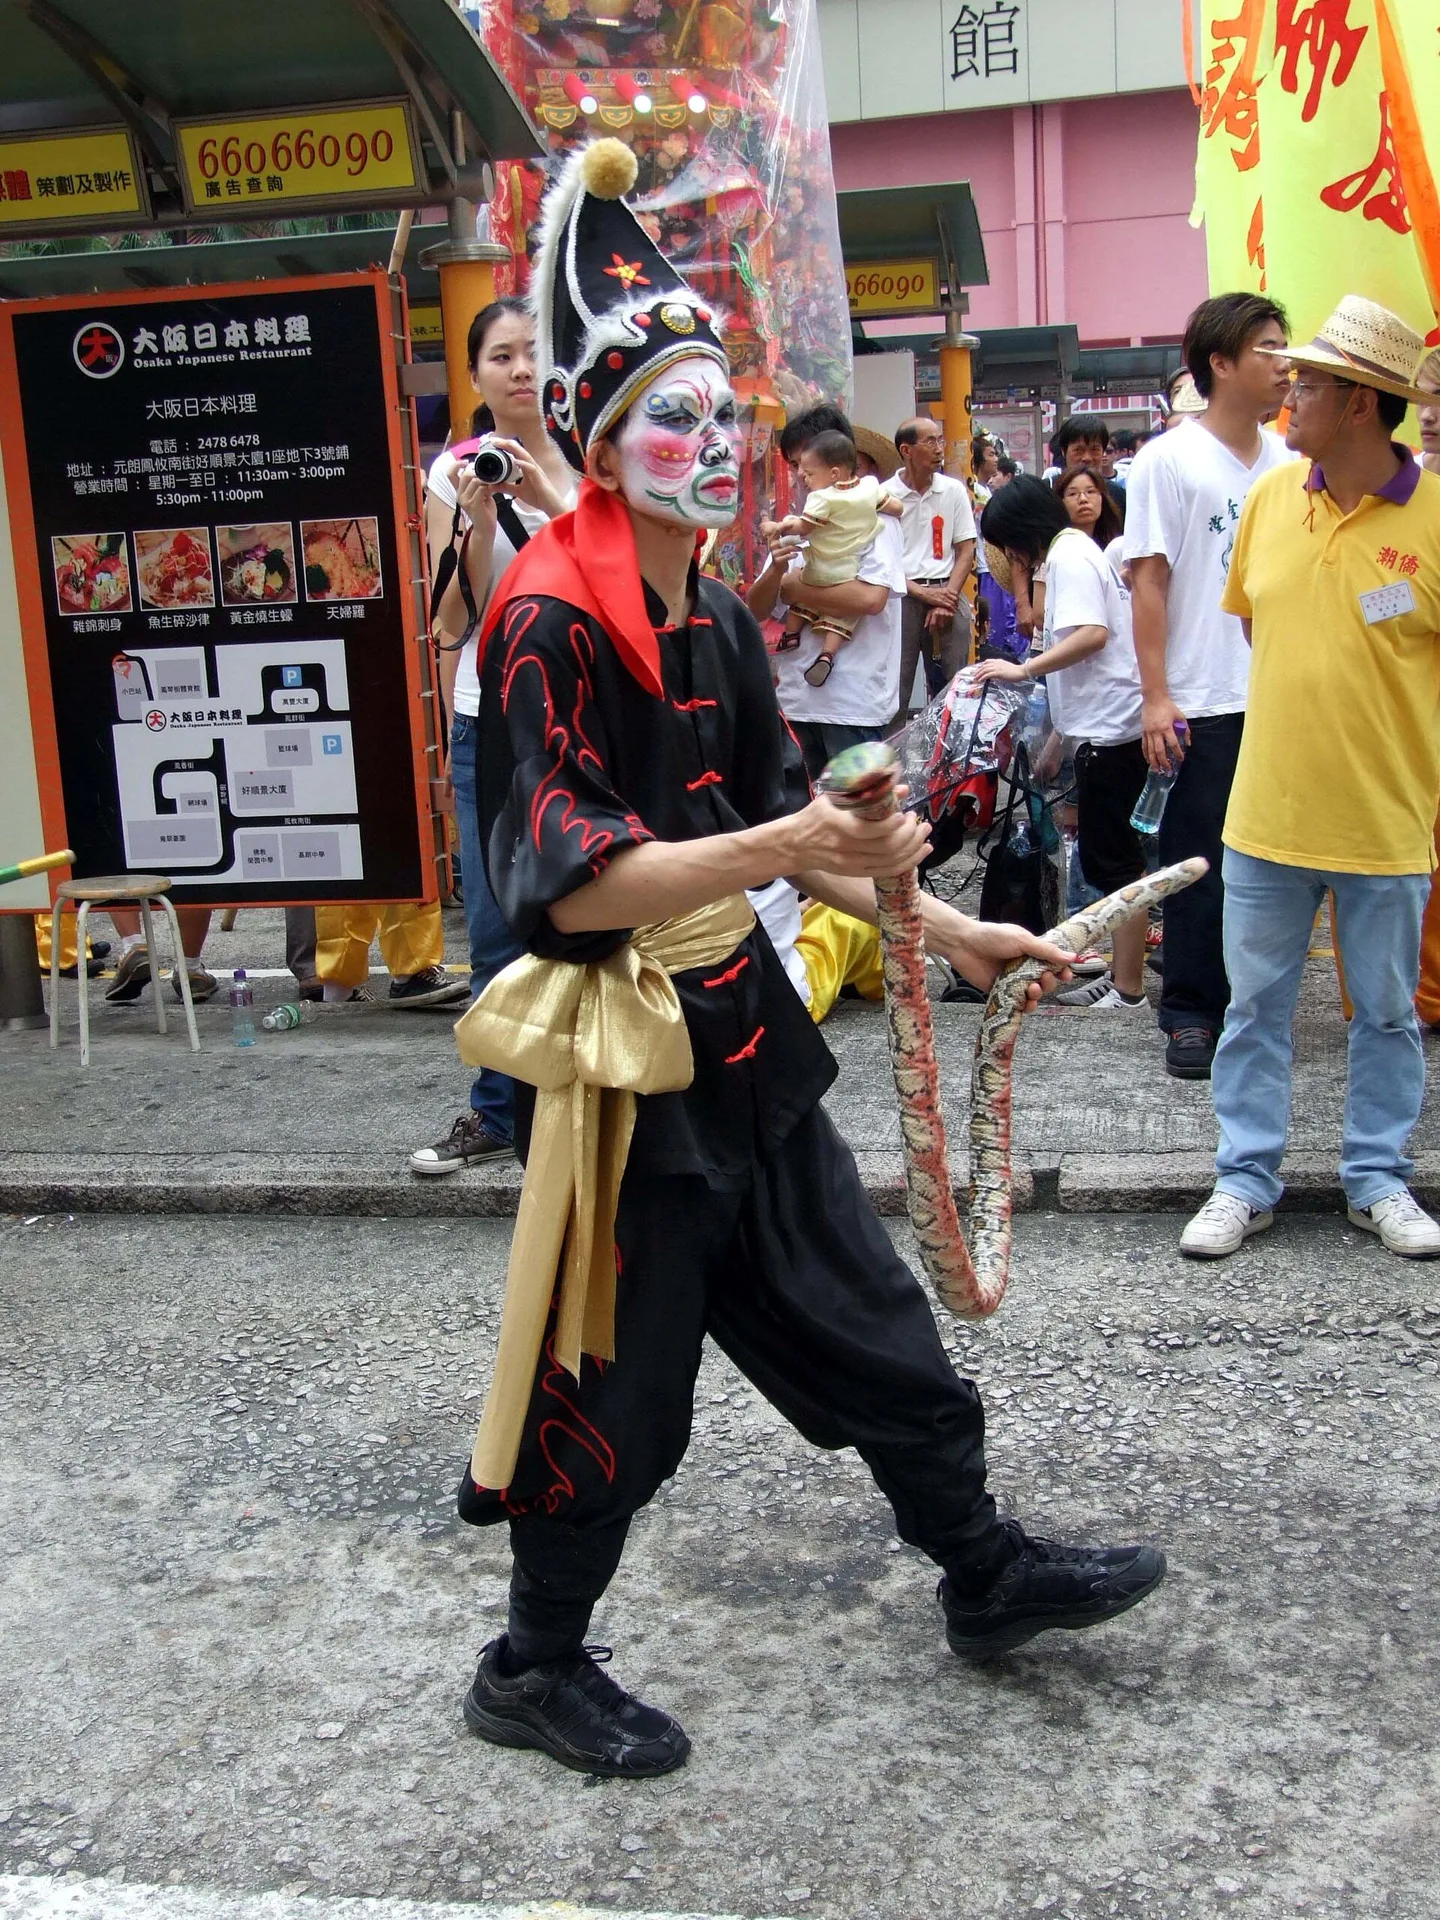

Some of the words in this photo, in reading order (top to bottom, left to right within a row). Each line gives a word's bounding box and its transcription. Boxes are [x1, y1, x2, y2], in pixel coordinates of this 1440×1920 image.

[949, 1, 1020, 81] 館
[198, 129, 394, 179] 66066090
[0, 169, 33, 201] 體
[36, 170, 132, 198] 策劃及製作
[205, 174, 284, 198] 廣告查詢
[132, 314, 312, 355] 大阪日本料理
[133, 357, 172, 369] Osaka
[176, 352, 235, 367] Japanese
[239, 346, 313, 360] Restaurant
[146, 393, 258, 421] 大阪日本料理
[197, 436, 228, 450] 2478
[229, 434, 260, 447] 6478
[237, 469, 290, 483] 11:30am
[299, 466, 346, 480] 3:00pm
[156, 492, 201, 507] 5:30pm
[211, 489, 264, 503] 11:00pm
[1376, 546, 1421, 576] 潮僑
[147, 613, 210, 630] 魚生碎沙律
[326, 604, 366, 620] 天婦羅
[72, 618, 123, 633] 雜錦刺身
[169, 708, 243, 724] 大阪日本料理
[241, 784, 288, 796] 好順景大廈
